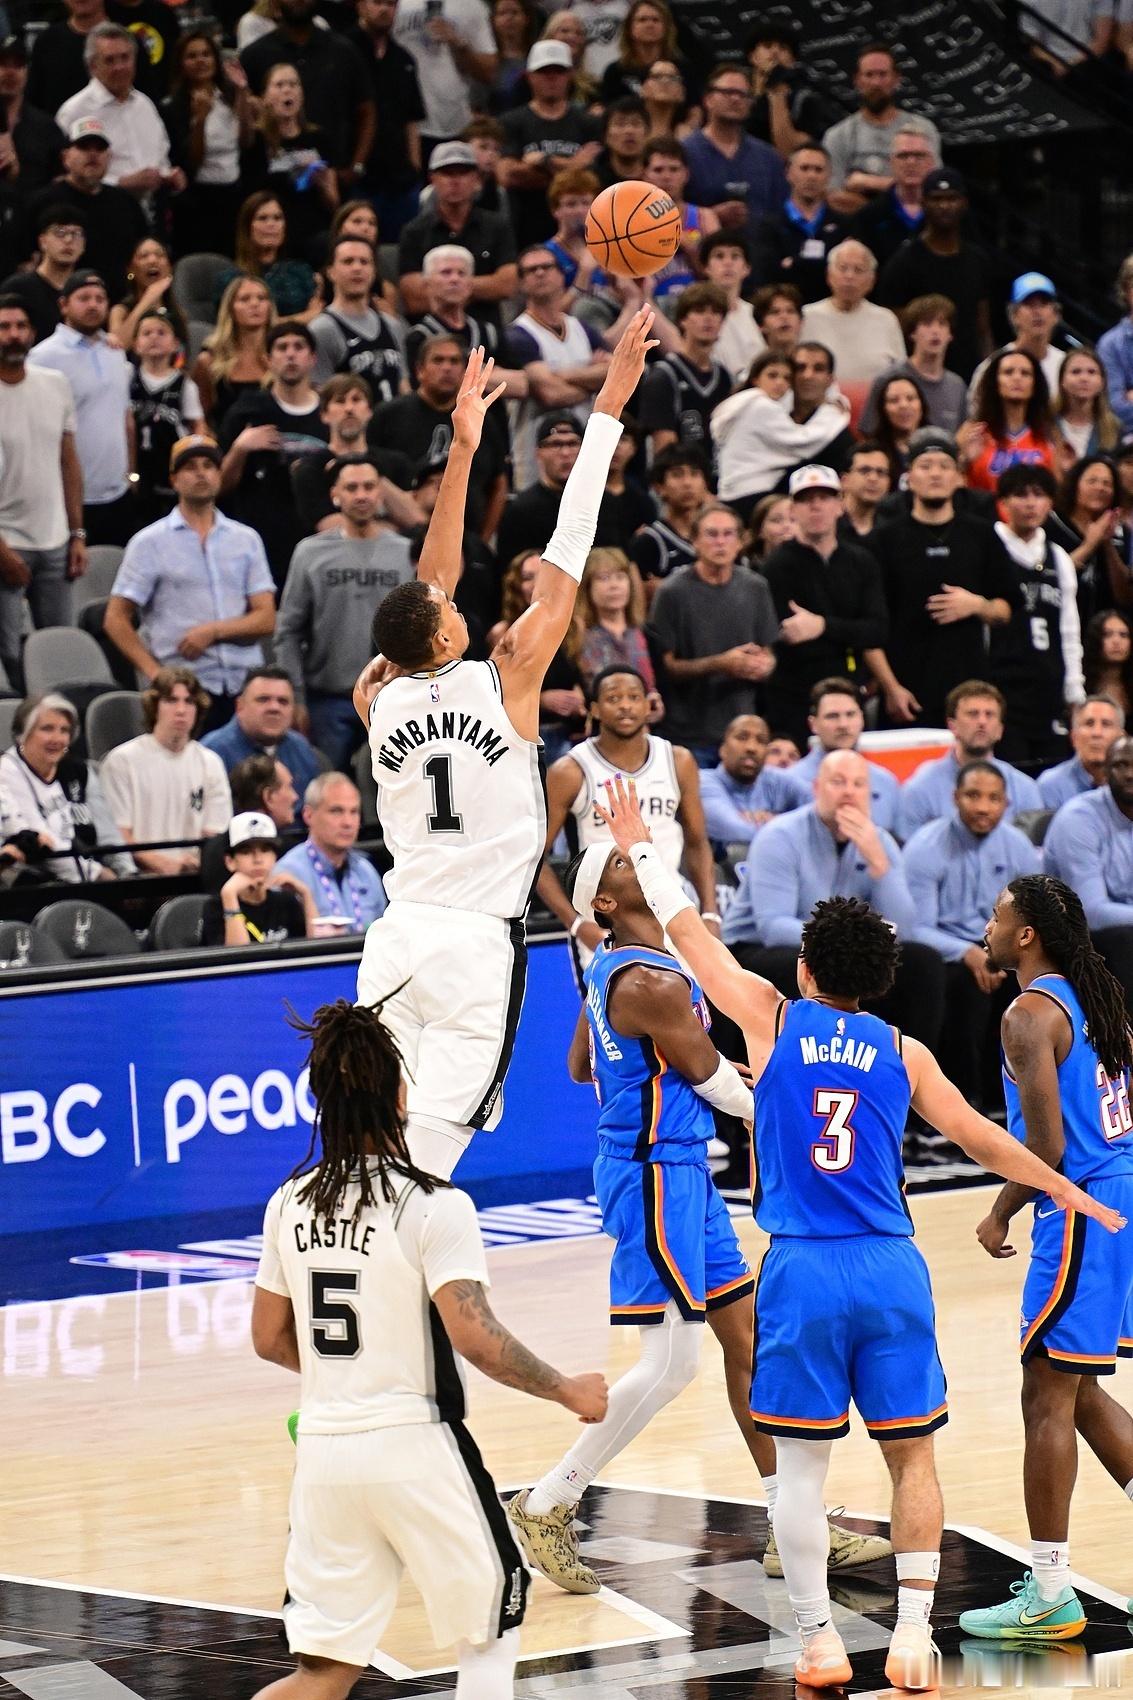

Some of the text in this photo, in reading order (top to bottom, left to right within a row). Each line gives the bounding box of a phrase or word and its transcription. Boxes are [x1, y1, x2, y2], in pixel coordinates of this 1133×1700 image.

[326, 567, 401, 589] SPURS
[1030, 616, 1051, 651] 5
[378, 711, 510, 774] WEMBANYAMA
[422, 753, 465, 835] 1
[799, 1036, 879, 1073] McCAIN
[810, 1087, 860, 1175] 3
[294, 1217, 377, 1257] CASTLE
[307, 1267, 365, 1361] 5
